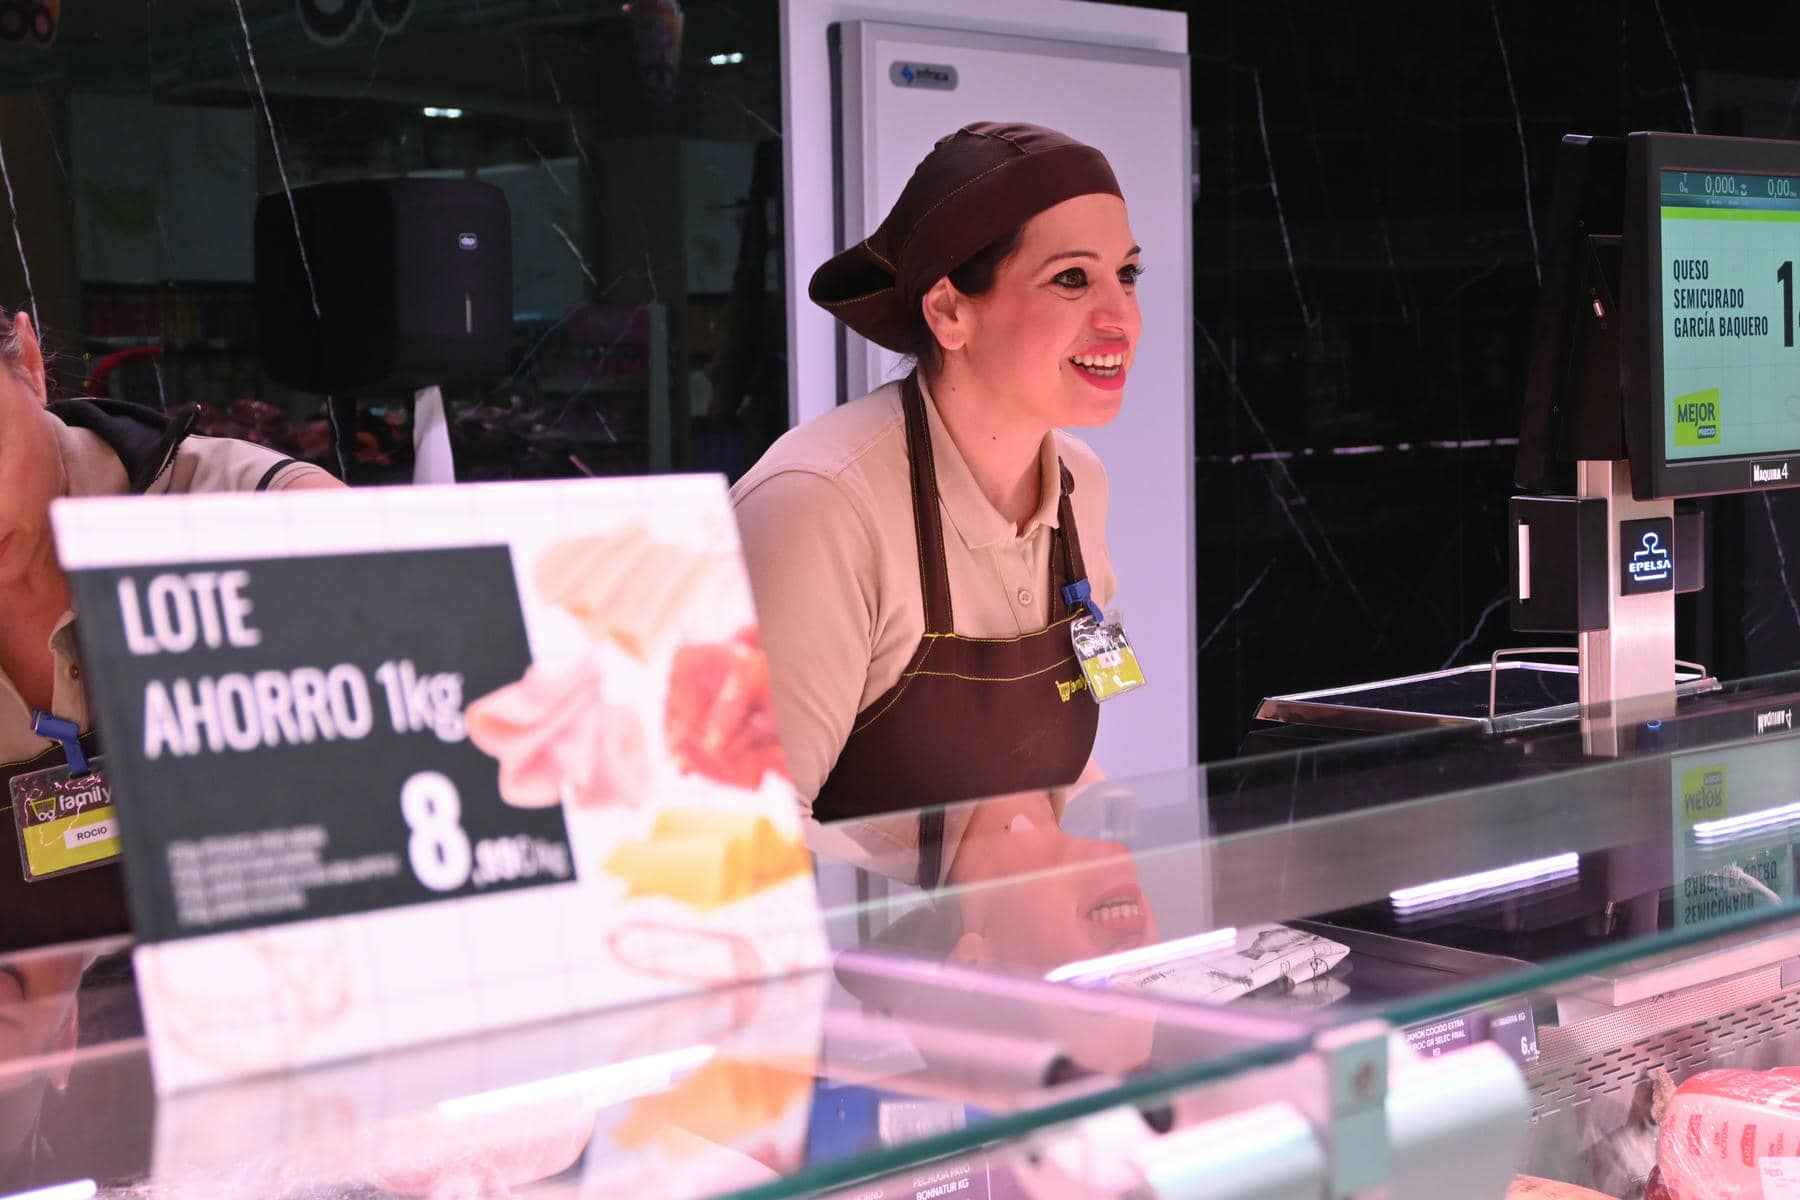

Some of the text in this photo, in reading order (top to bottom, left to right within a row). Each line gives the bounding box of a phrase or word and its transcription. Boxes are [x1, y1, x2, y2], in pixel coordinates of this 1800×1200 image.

[1705, 175, 1735, 197] 0,000
[1767, 179, 1790, 199] 0,00
[1673, 259, 1709, 283] QUESO
[1673, 288, 1744, 309] SEMICURADO
[1674, 311, 1769, 339] GARCÍA BAQUERO
[1781, 462, 1789, 479] 4
[1628, 560, 1672, 573] EPELSA
[118, 570, 261, 655] LOTE
[144, 658, 466, 760] AHORRO 1kg
[59, 785, 112, 811] family
[77, 826, 108, 841] ROCIO
